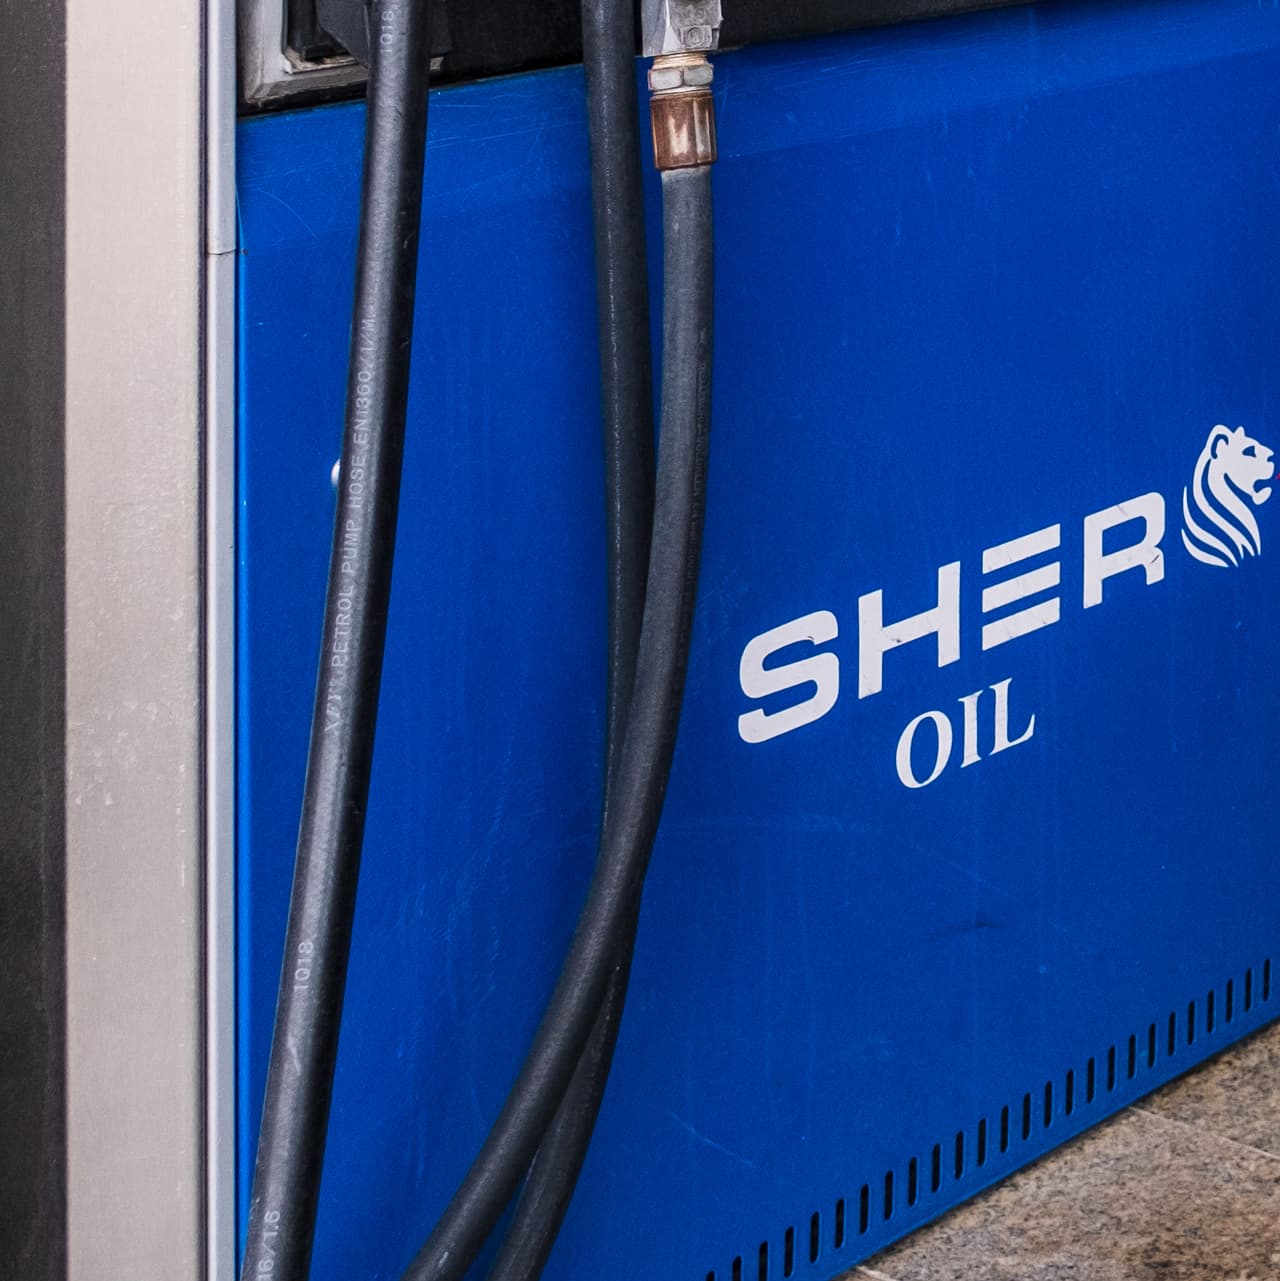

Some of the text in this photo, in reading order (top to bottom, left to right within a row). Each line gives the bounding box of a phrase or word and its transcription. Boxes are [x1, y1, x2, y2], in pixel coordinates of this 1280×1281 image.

[348, 455, 367, 509] HOSE
[341, 519, 362, 573] PUMP
[330, 585, 354, 668] PETROL
[738, 491, 1165, 744] SHER
[895, 677, 1035, 790] OIL
